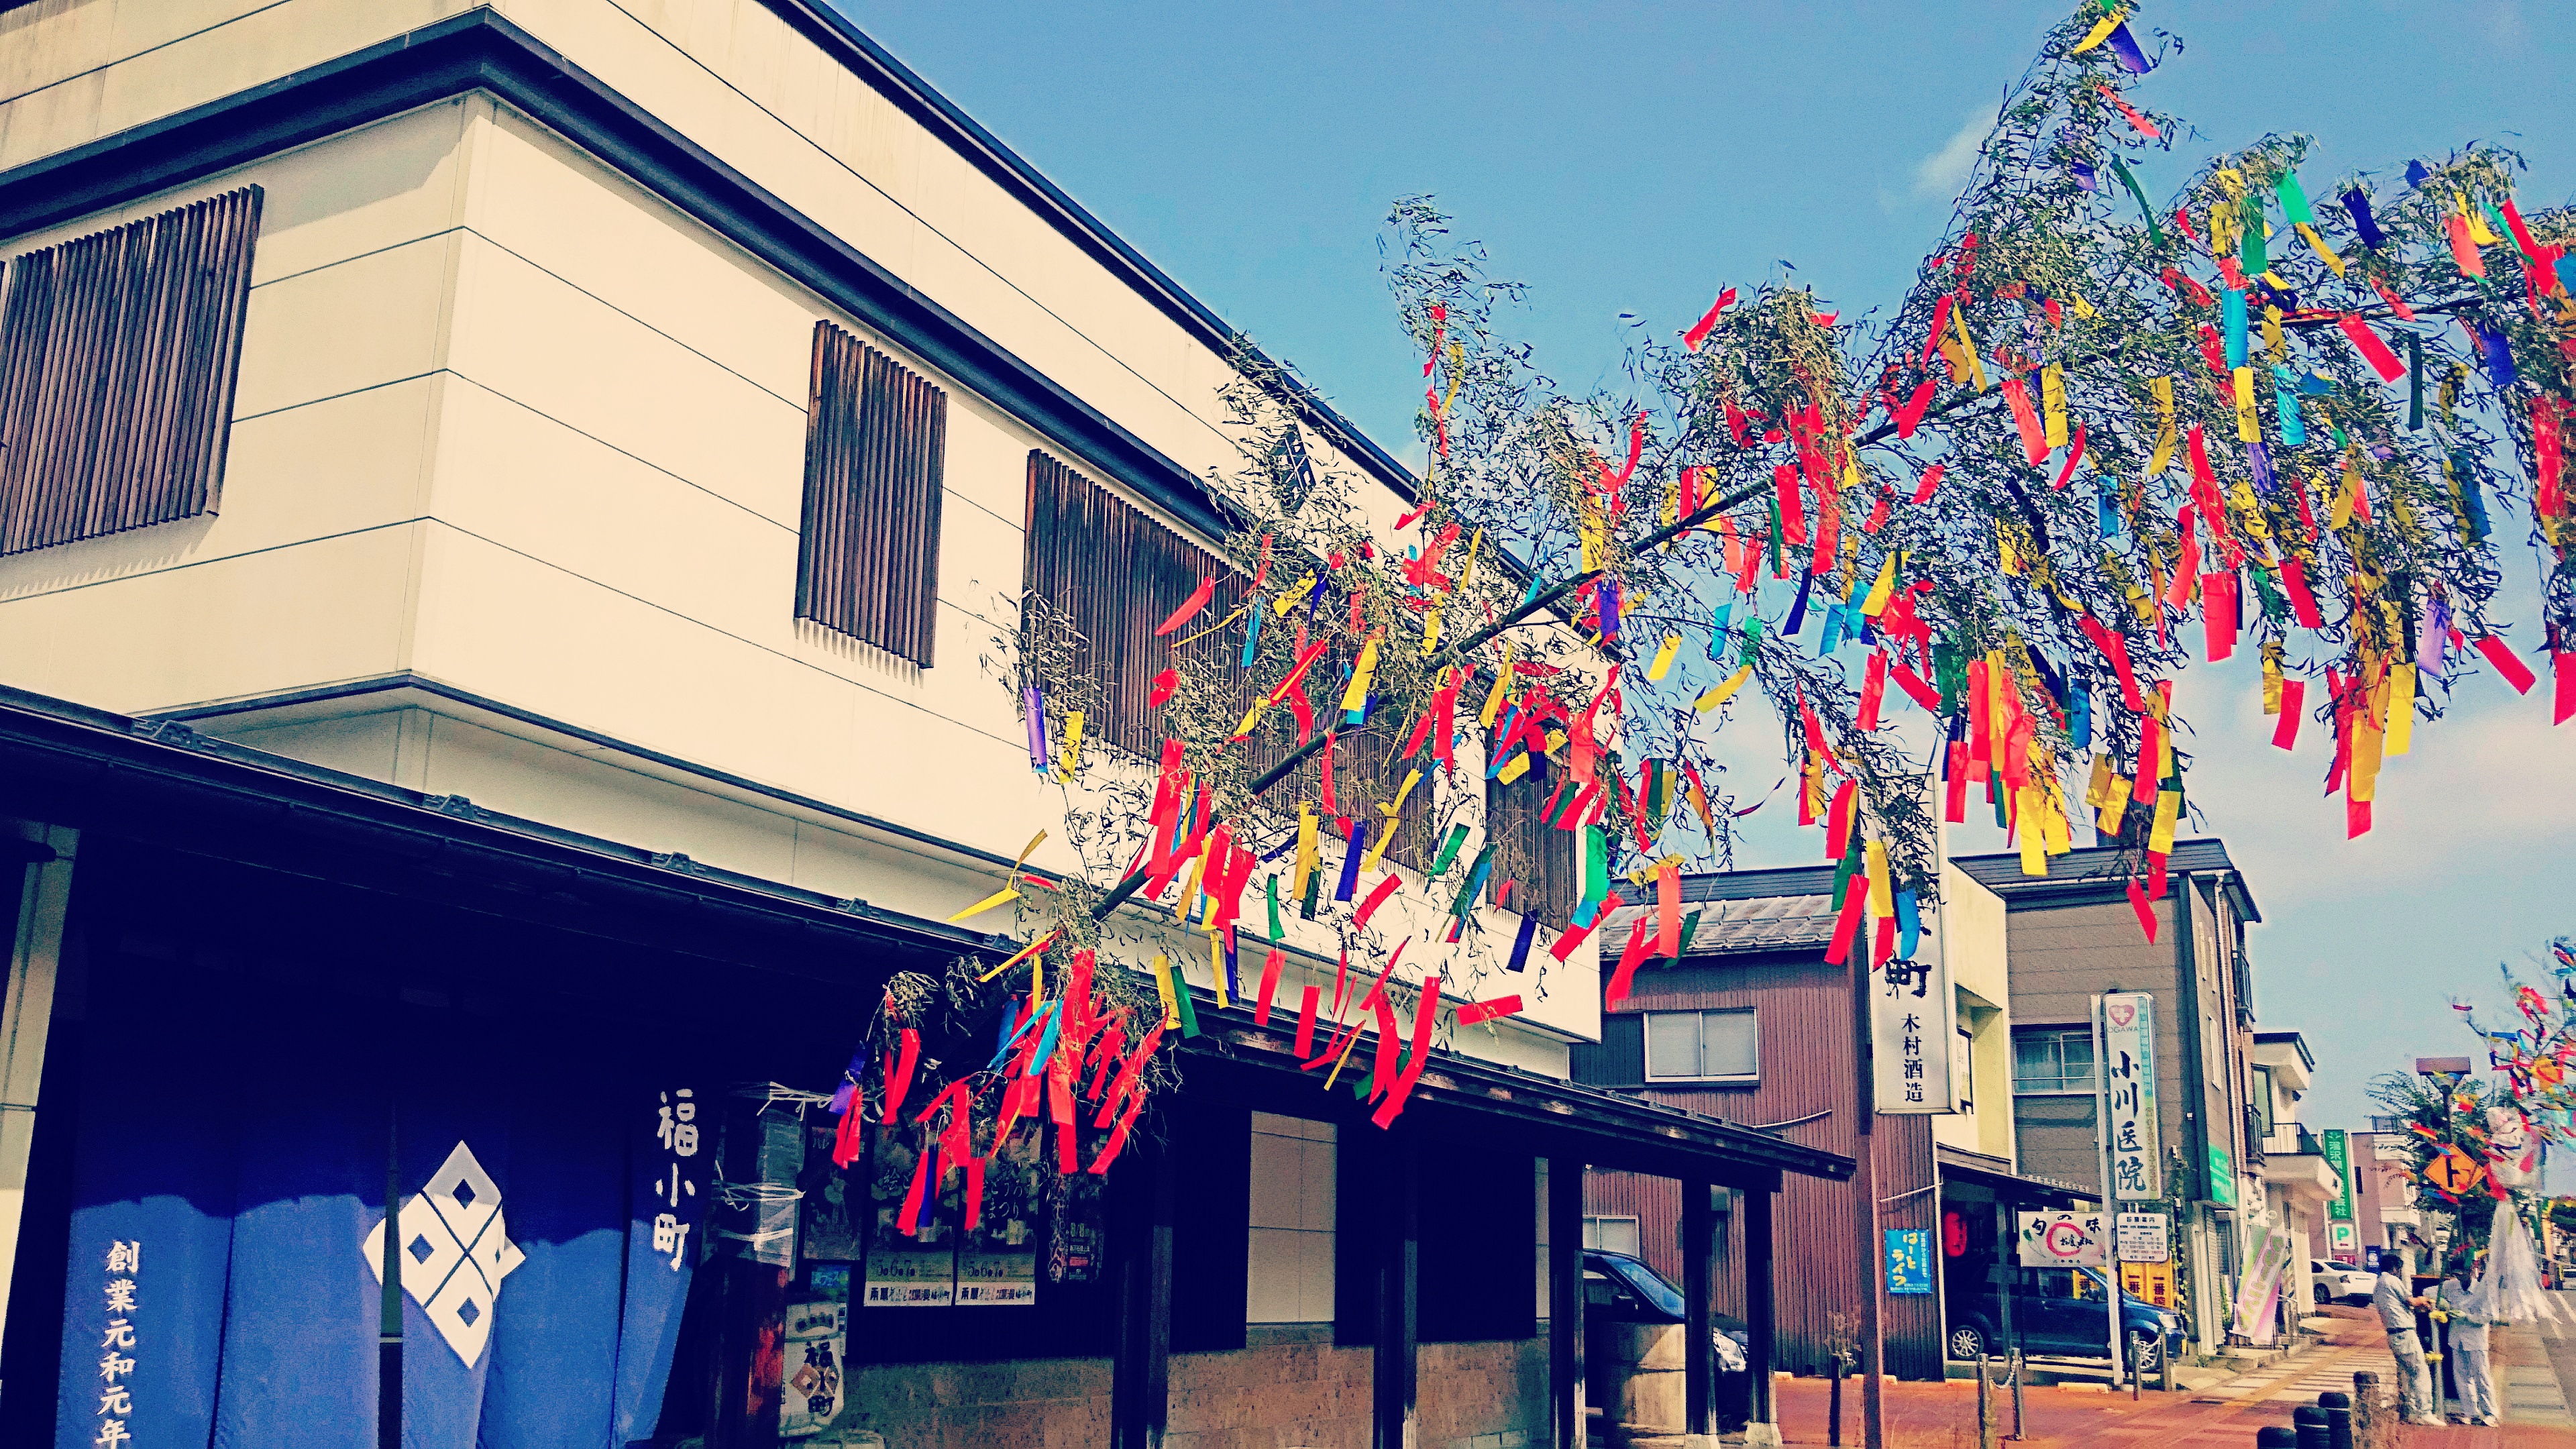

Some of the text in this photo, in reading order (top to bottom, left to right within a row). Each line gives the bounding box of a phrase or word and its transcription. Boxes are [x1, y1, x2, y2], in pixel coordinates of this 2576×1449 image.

[1900, 1012, 1924, 1103] 木村酒造
[2108, 1026, 2139, 1034] OGAWA
[2110, 1051, 2147, 1192] 小川医院
[653, 1088, 699, 1273] 福小町
[2031, 1214, 2101, 1236] 旬の味
[2337, 1227, 2350, 1241] P
[95, 1241, 140, 1449] 創業元和元年
[803, 1334, 835, 1417] 福小町
